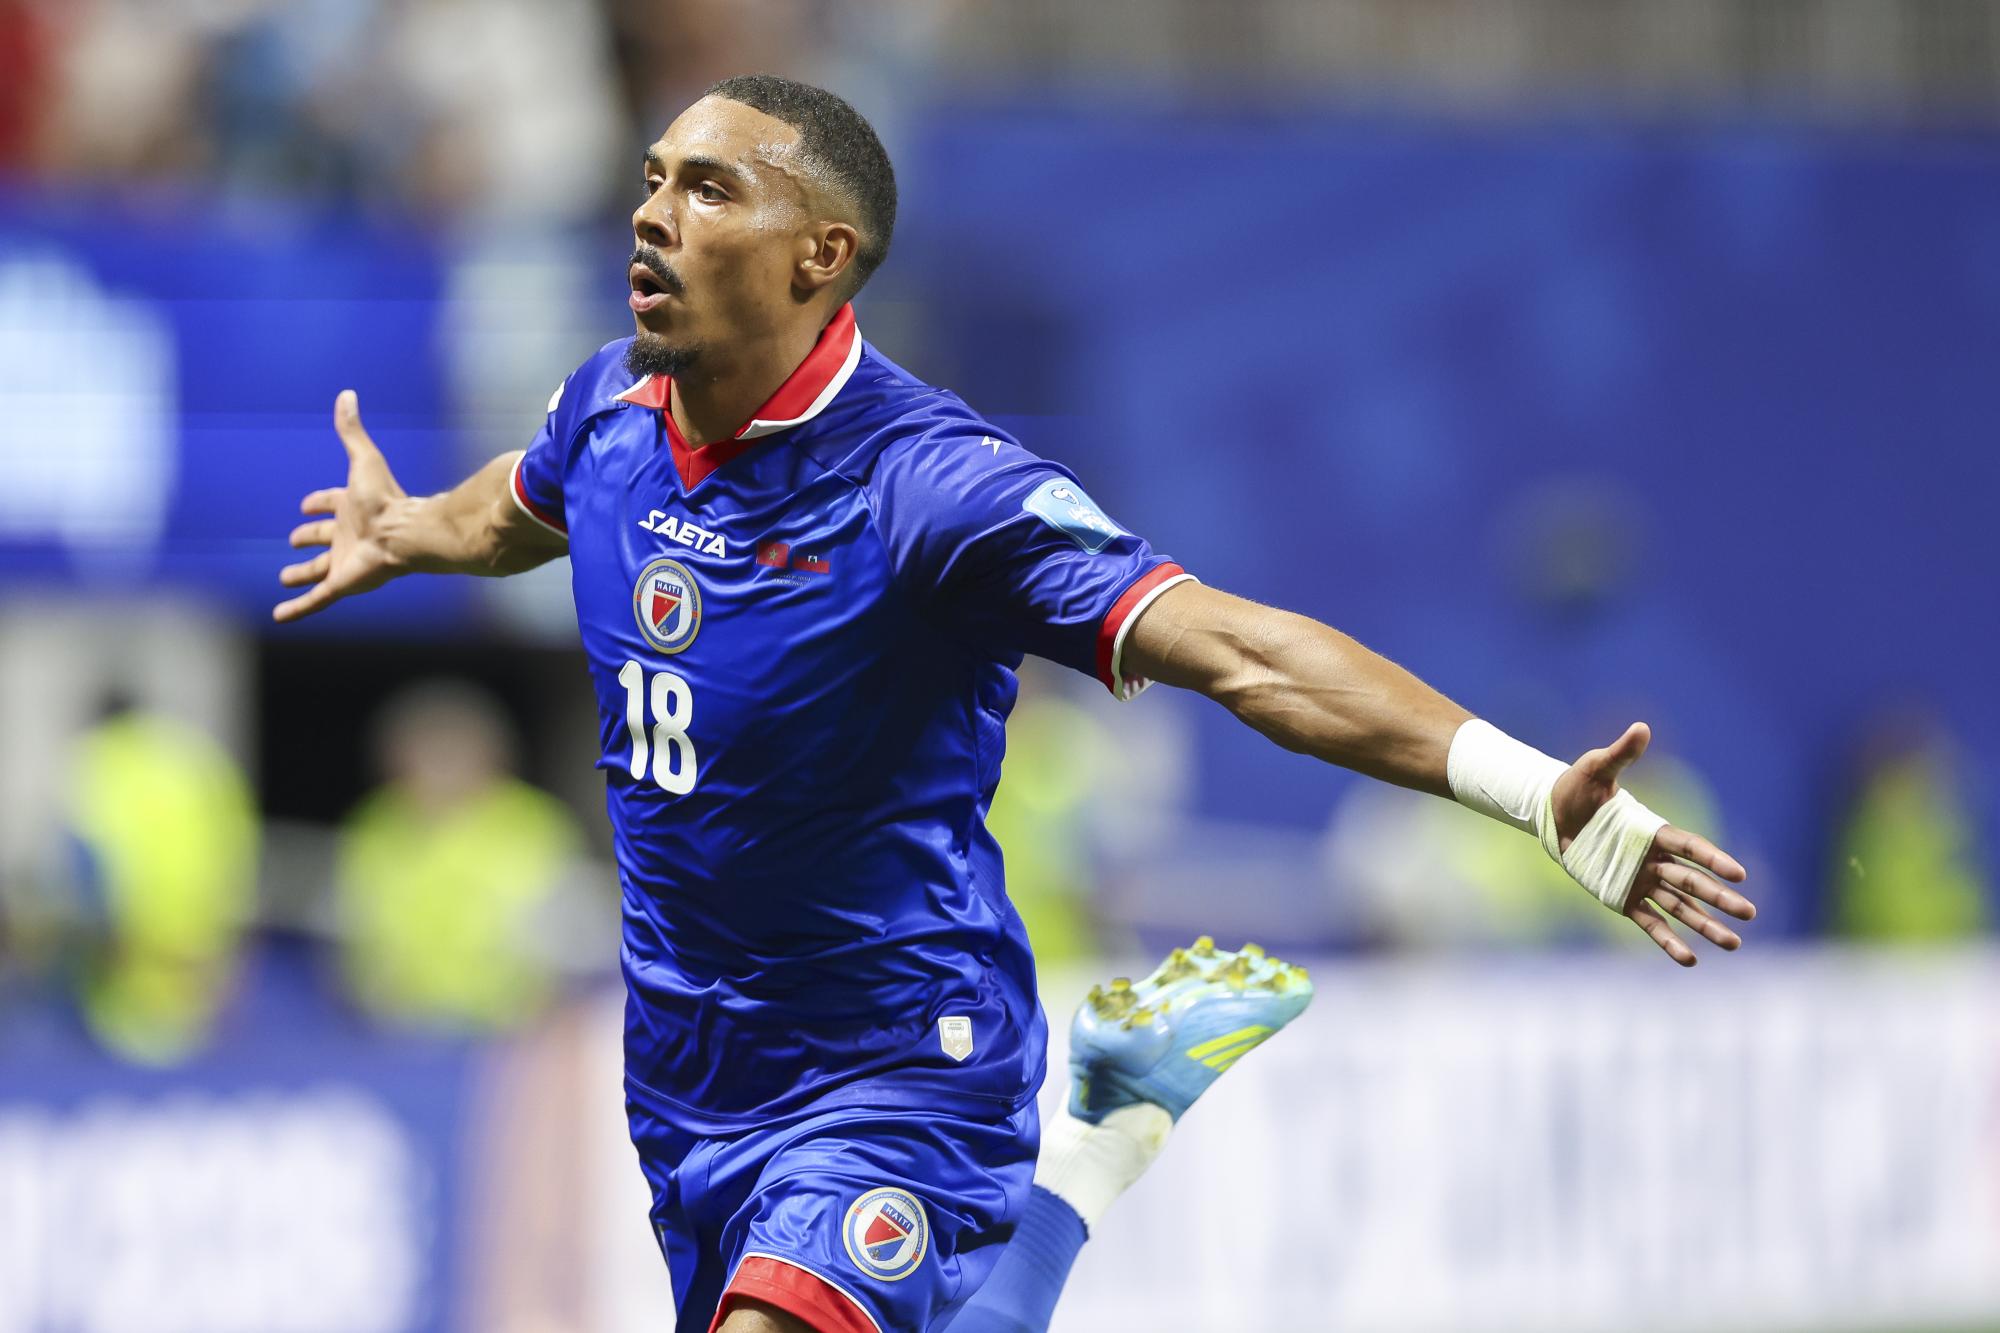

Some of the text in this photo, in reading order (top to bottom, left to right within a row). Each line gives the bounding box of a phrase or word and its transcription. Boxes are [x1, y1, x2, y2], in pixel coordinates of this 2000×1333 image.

[638, 509, 727, 559] SAETA
[657, 581, 680, 595] HAITI
[618, 660, 697, 795] 18
[885, 1206, 911, 1230] HAITI
